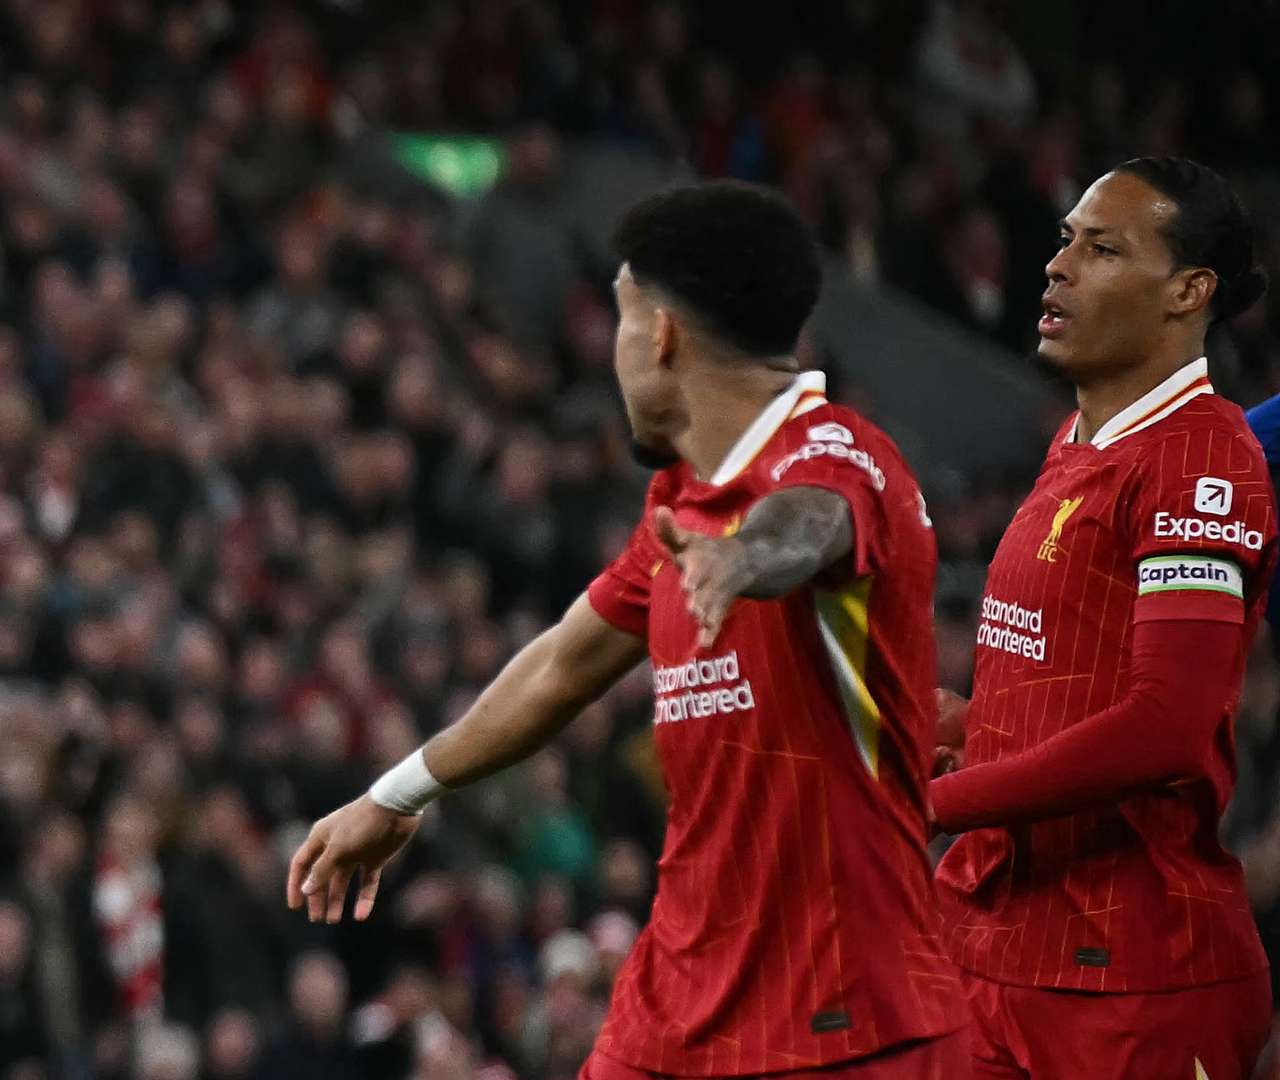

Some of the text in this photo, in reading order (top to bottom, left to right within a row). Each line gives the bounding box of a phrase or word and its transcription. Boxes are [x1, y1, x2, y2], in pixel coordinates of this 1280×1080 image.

[1154, 511, 1264, 551] Expedia
[981, 593, 1043, 635] standard
[977, 619, 1047, 662] chartered
